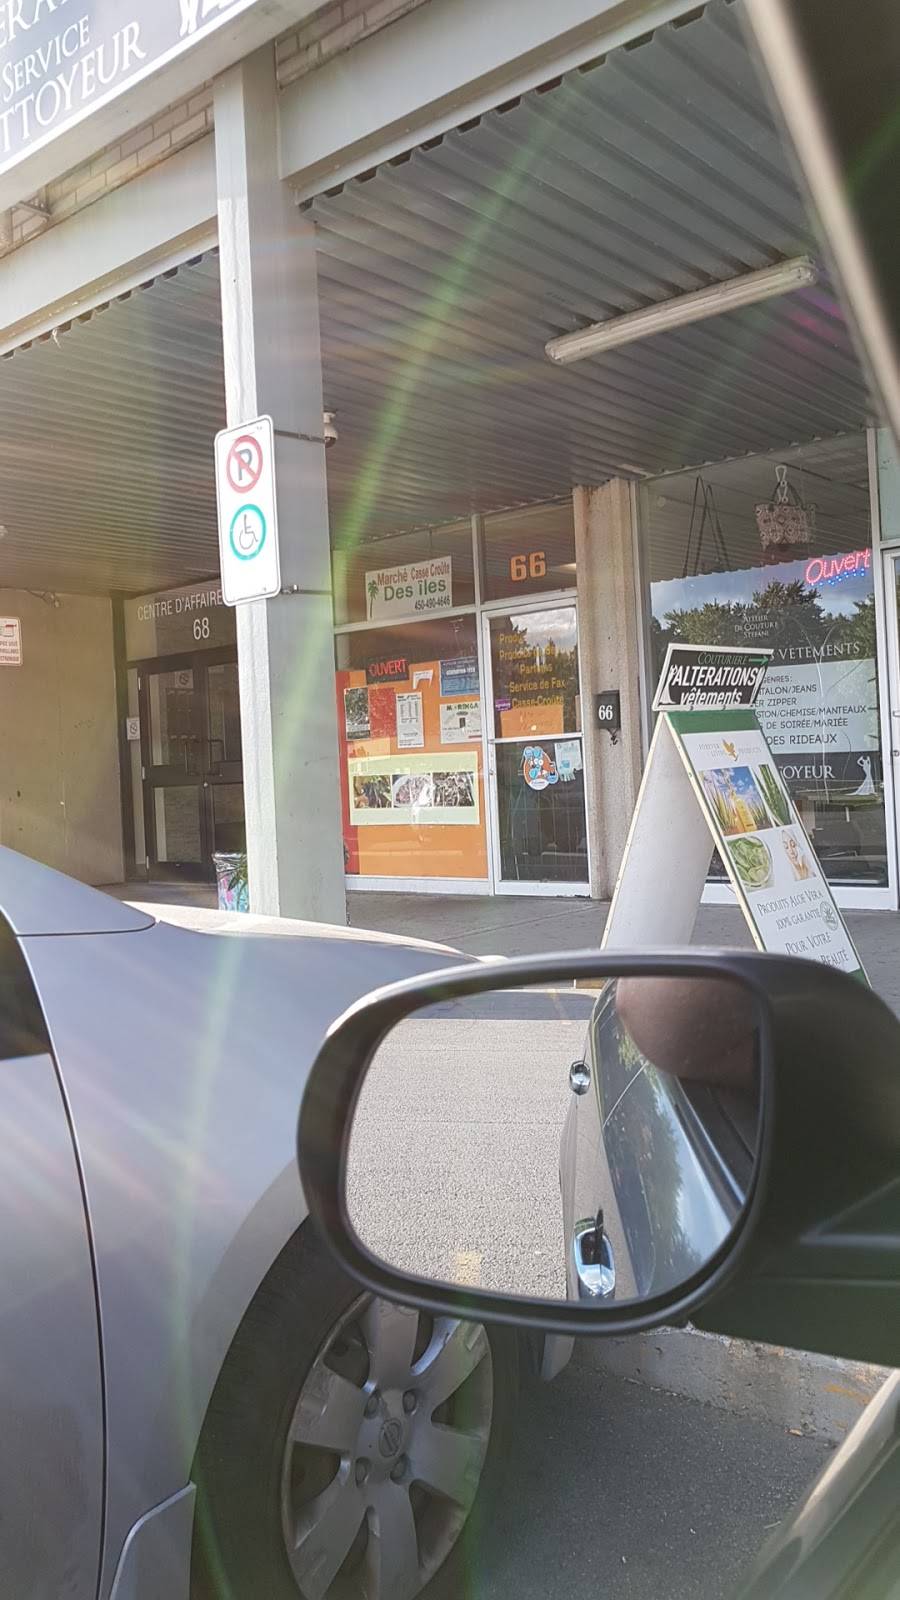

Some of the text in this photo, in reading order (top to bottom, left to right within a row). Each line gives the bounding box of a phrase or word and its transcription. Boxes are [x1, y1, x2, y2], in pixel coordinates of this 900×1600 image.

[2, 14, 91, 102] SERVICE
[510, 551, 546, 581] 66
[806, 547, 870, 584] Ouvert
[377, 568, 408, 586] Marché
[411, 567, 429, 580] Casse
[384, 586, 414, 601] Des
[137, 600, 173, 621] CENTRE
[193, 617, 210, 640] 68
[368, 659, 406, 677] OUVERT
[671, 665, 758, 686] ALTERATIONS
[551, 677, 566, 689] Fax
[680, 687, 742, 705] vêtements
[768, 697, 798, 706] ZIPPER
[598, 704, 613, 721] 66
[766, 721, 777, 730] DE
[767, 734, 837, 746] DES RIDEAUX
